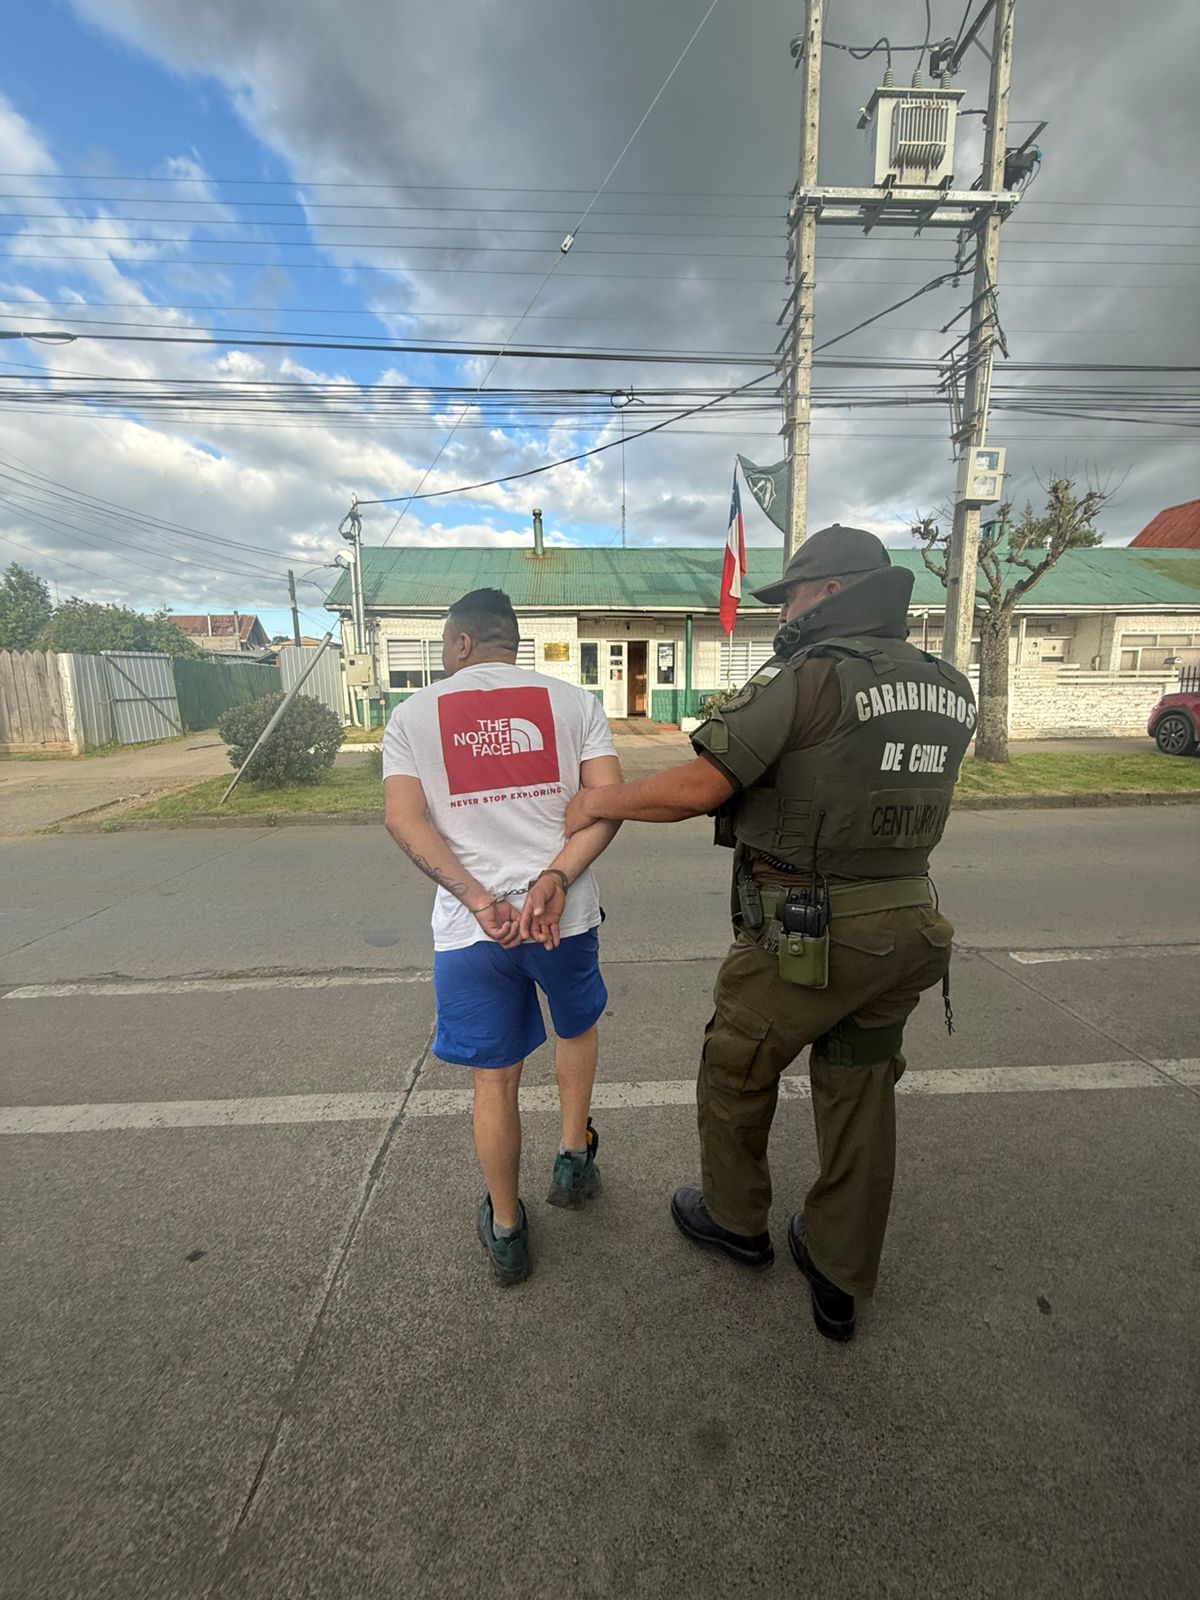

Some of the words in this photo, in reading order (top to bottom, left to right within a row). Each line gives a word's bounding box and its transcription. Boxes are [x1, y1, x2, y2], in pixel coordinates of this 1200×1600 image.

[855, 682, 977, 729] CARABINEROS
[477, 718, 509, 731] THE
[453, 730, 511, 746] NORTH
[472, 743, 511, 757] FACE
[880, 742, 905, 771] DE
[908, 744, 948, 773] CHILE
[450, 798, 479, 808] NEVER
[483, 794, 507, 804] STOP
[510, 787, 562, 800] EXPLORING
